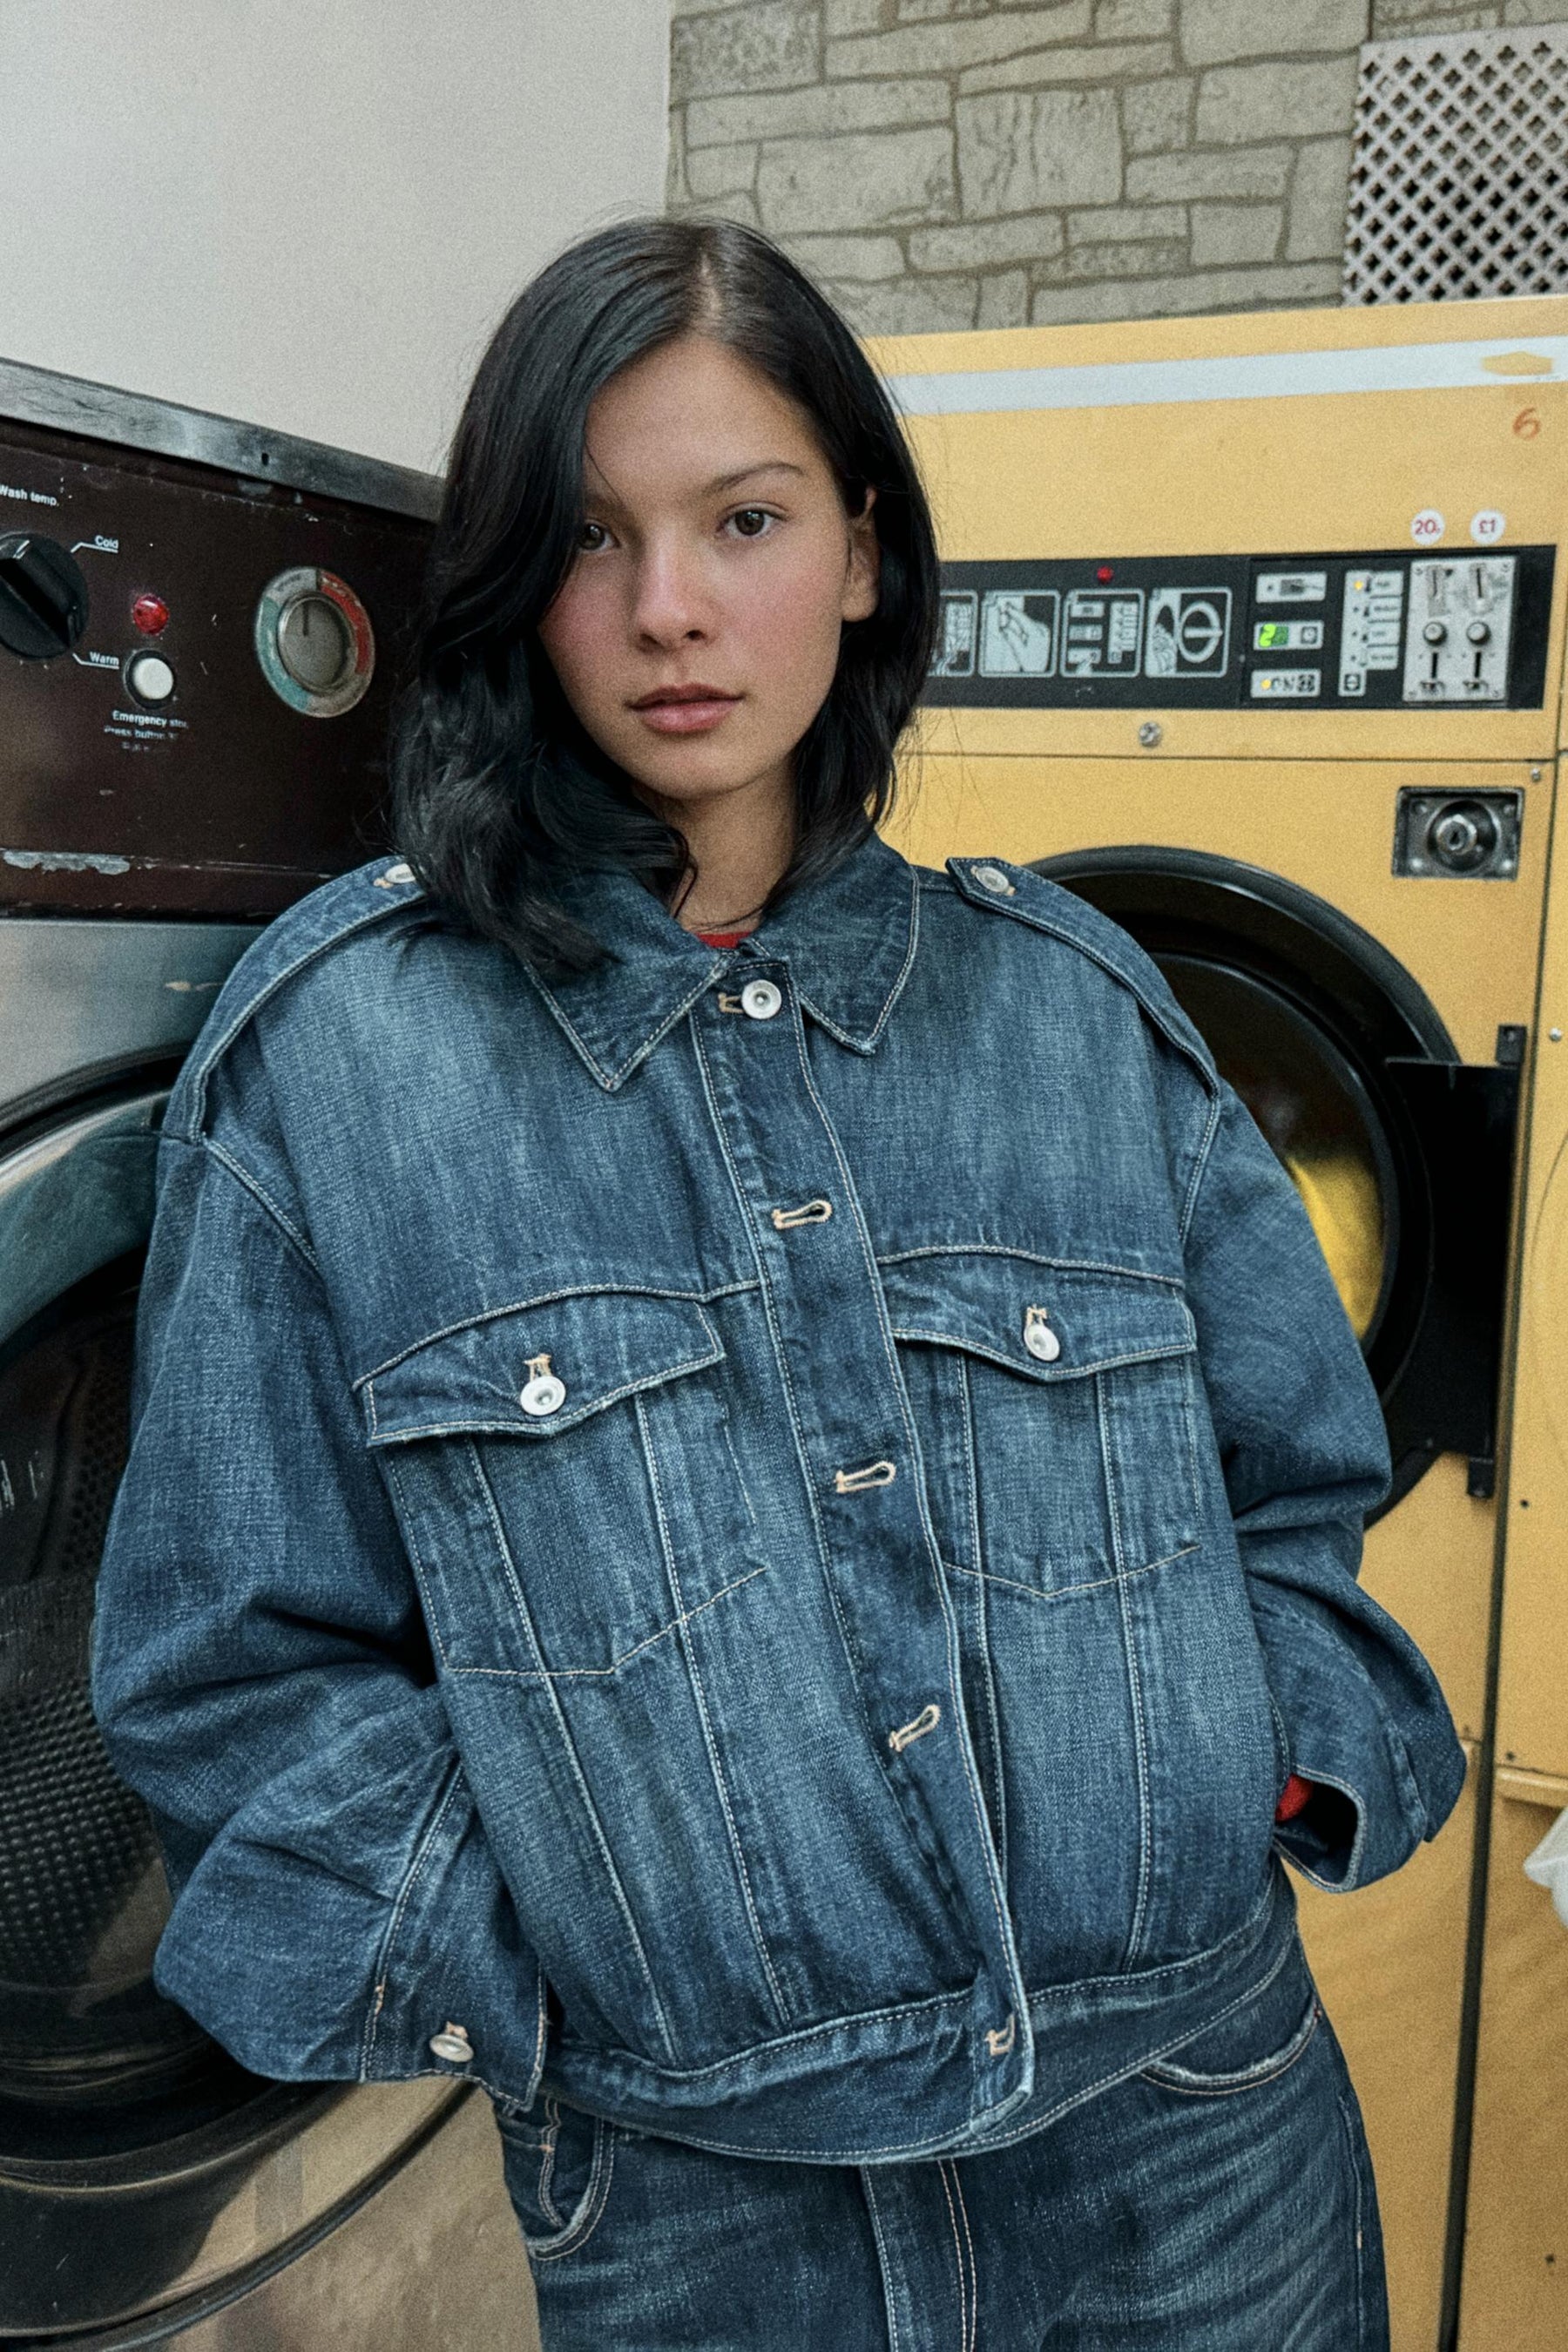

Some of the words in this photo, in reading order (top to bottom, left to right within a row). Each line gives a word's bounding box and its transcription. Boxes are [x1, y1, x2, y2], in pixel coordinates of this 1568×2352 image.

[1512, 407, 1541, 442] 6
[0, 484, 28, 500] Wash
[1478, 519, 1496, 534] £1
[94, 535, 119, 549] Cold
[90, 652, 119, 665] Warm
[112, 710, 167, 727] Emergency
